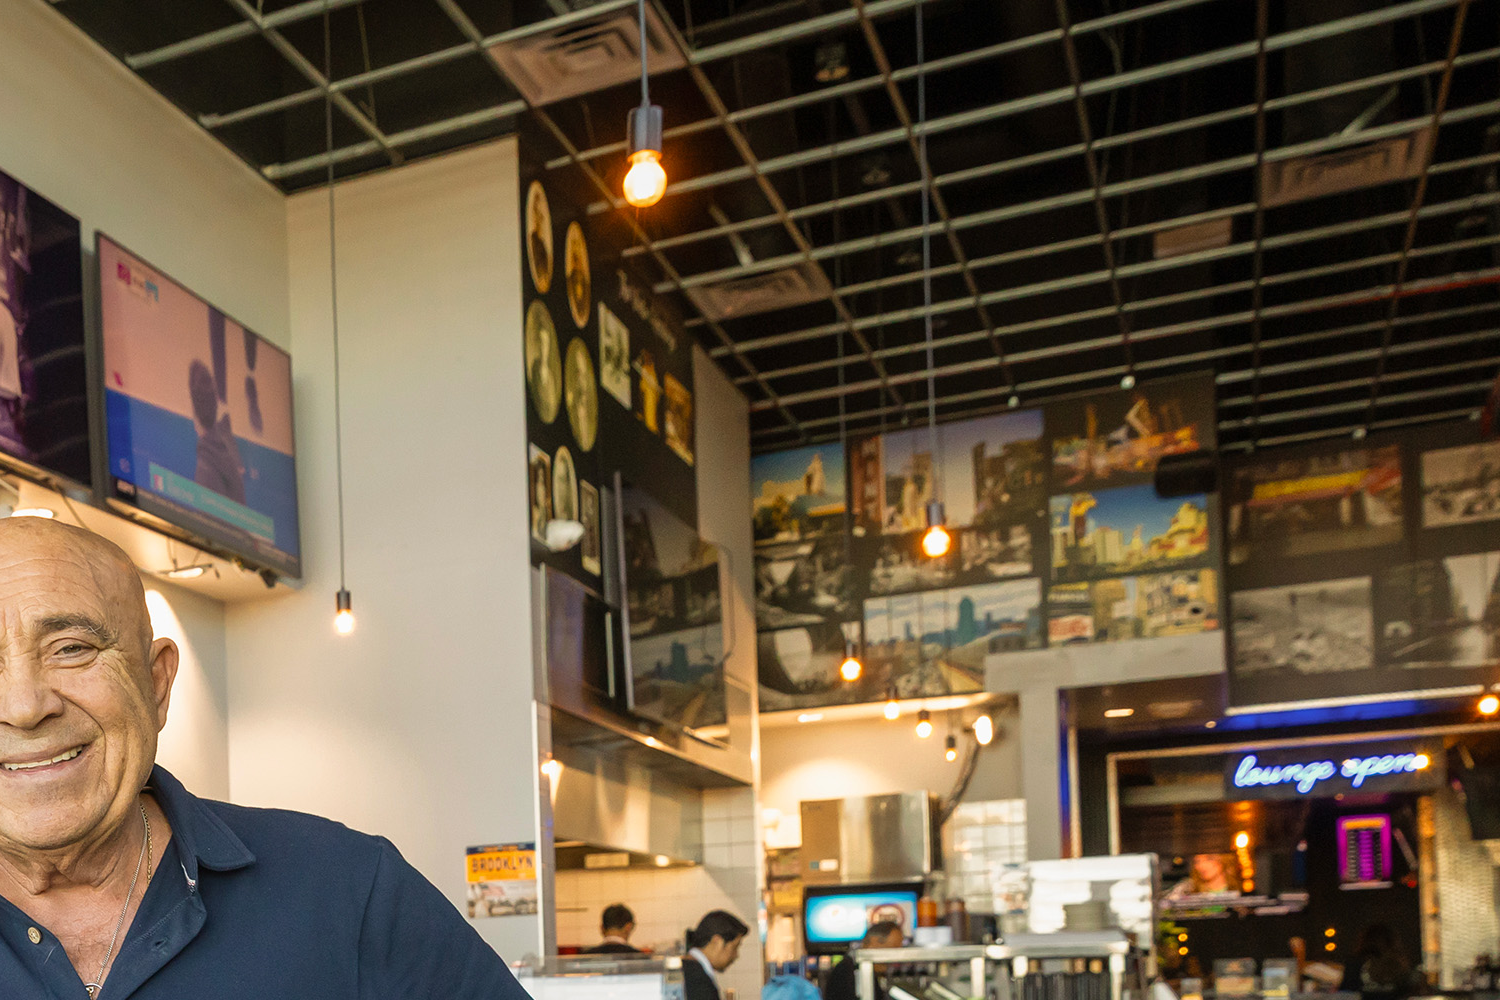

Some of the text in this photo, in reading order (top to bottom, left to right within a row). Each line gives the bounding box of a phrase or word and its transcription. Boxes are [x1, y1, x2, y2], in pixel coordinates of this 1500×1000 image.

[1234, 752, 1419, 793] lounge open
[471, 855, 534, 873] BROOKLYN
